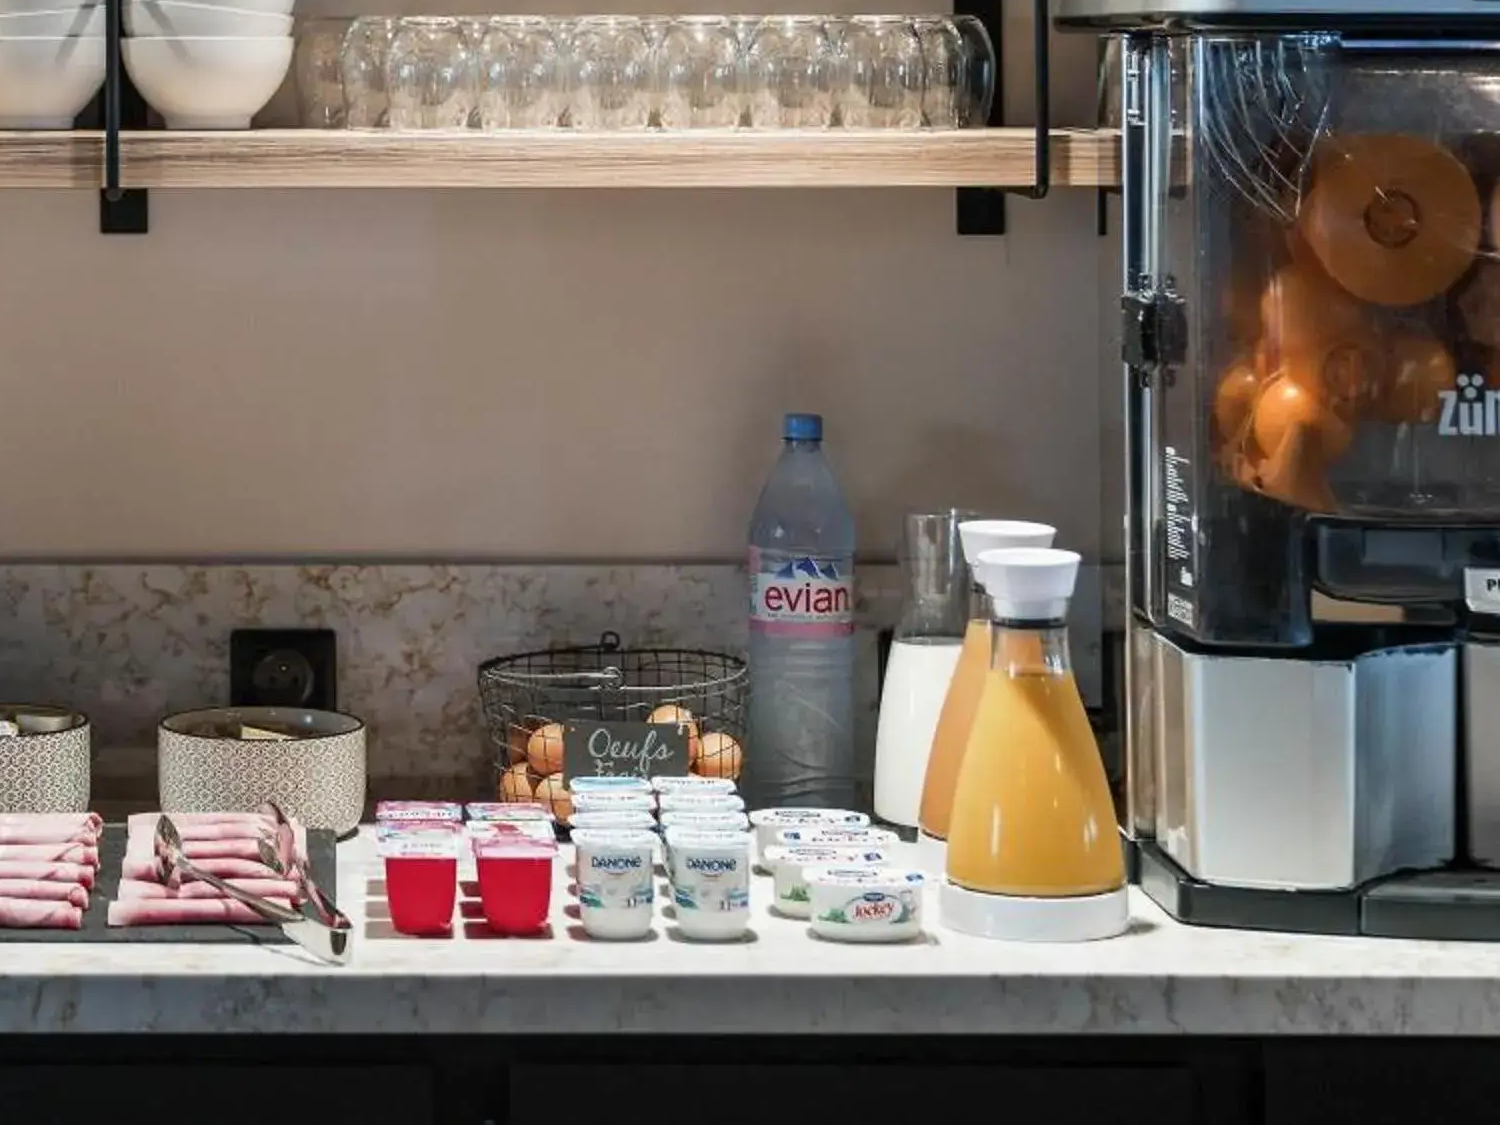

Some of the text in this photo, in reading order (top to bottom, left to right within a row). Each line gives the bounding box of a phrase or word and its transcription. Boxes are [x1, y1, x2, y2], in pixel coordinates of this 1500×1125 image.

[764, 582, 849, 613] evian
[587, 727, 675, 773] Oeufs
[591, 855, 642, 869] DANONE
[686, 857, 737, 872] DANONE
